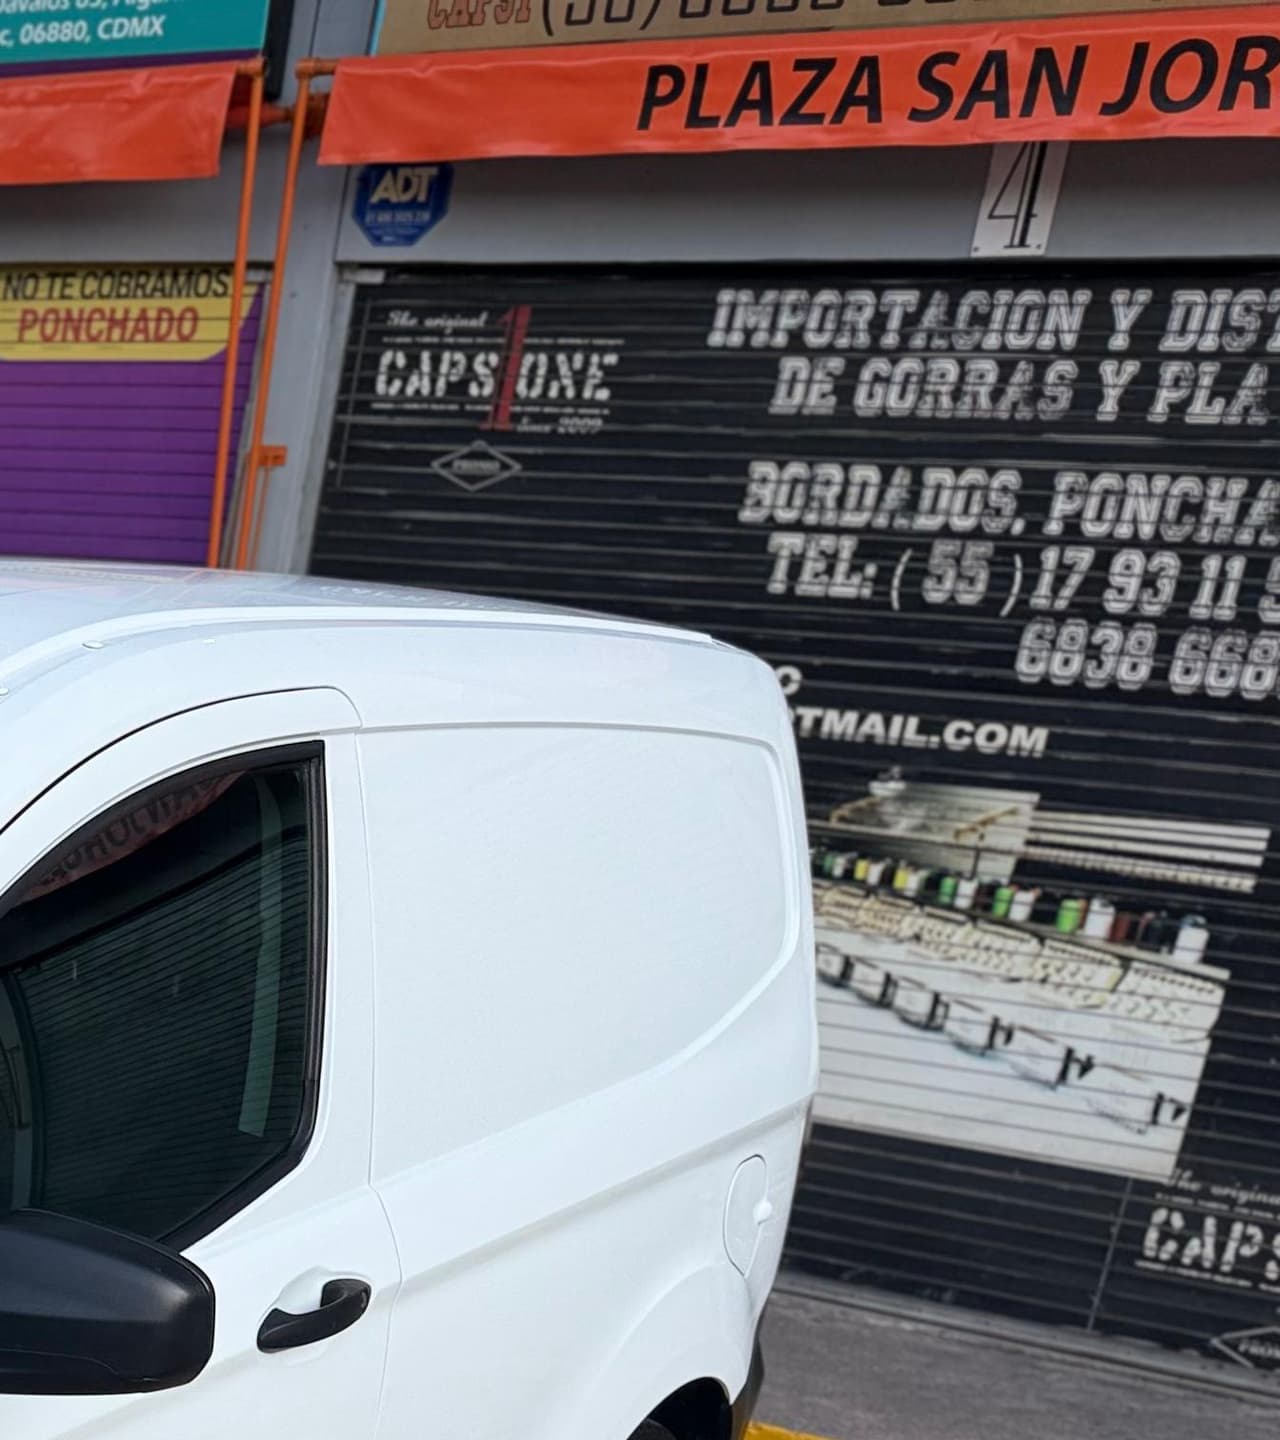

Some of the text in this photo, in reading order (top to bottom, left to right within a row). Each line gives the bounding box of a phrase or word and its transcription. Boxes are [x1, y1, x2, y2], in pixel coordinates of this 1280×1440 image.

[19, 22, 91, 44] 06880,
[97, 16, 166, 39] CDMX
[637, 36, 1280, 131] PLAZA SAN JOR
[370, 166, 439, 203] ADT
[985, 142, 1042, 250] 4
[2, 267, 231, 300] NO TE COBRAMOS
[17, 306, 199, 343] PONCHADO
[707, 288, 1091, 351] IMPORTACION
[1108, 290, 1151, 351] Y
[769, 357, 1269, 425] DE GORRAS Y PLA
[766, 532, 878, 598] TEL:
[1103, 550, 1181, 617] 93
[1189, 554, 1246, 620] 11
[1016, 618, 1157, 690] 6838
